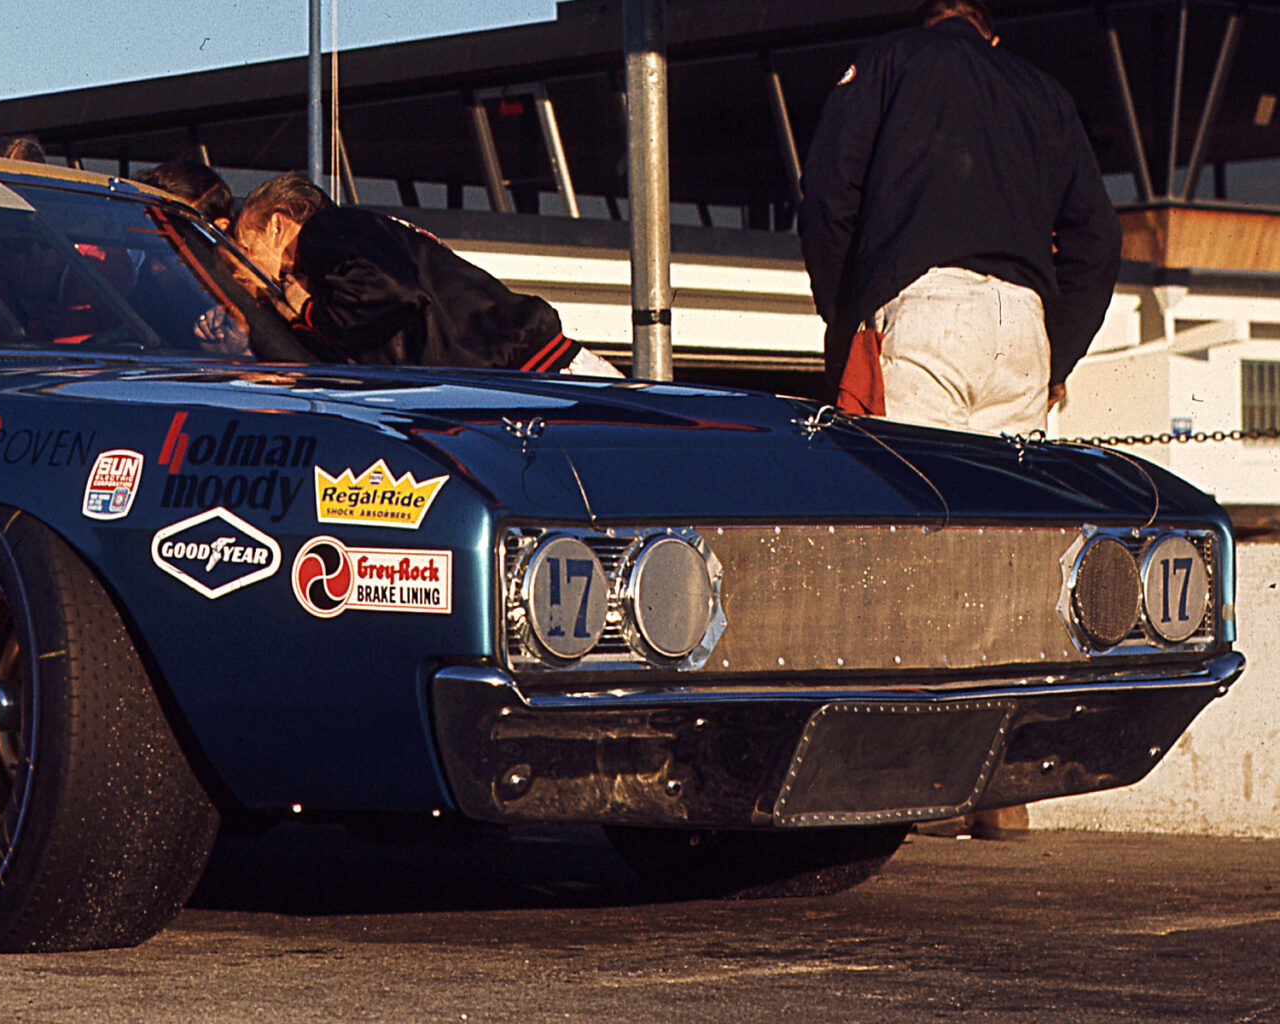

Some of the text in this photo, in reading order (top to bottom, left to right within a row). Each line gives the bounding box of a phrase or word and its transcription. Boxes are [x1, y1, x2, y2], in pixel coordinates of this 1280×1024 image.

[157, 411, 317, 474] holman
[97, 457, 139, 476] SUN
[160, 470, 304, 523] moody
[322, 486, 425, 508] Regal Ride
[326, 507, 412, 521] SHOCK ABSORBERS
[161, 536, 269, 572] GOODYEAR
[357, 585, 440, 605] BRAKE LINING
[546, 556, 594, 639] 17
[1160, 557, 1193, 623] 17
